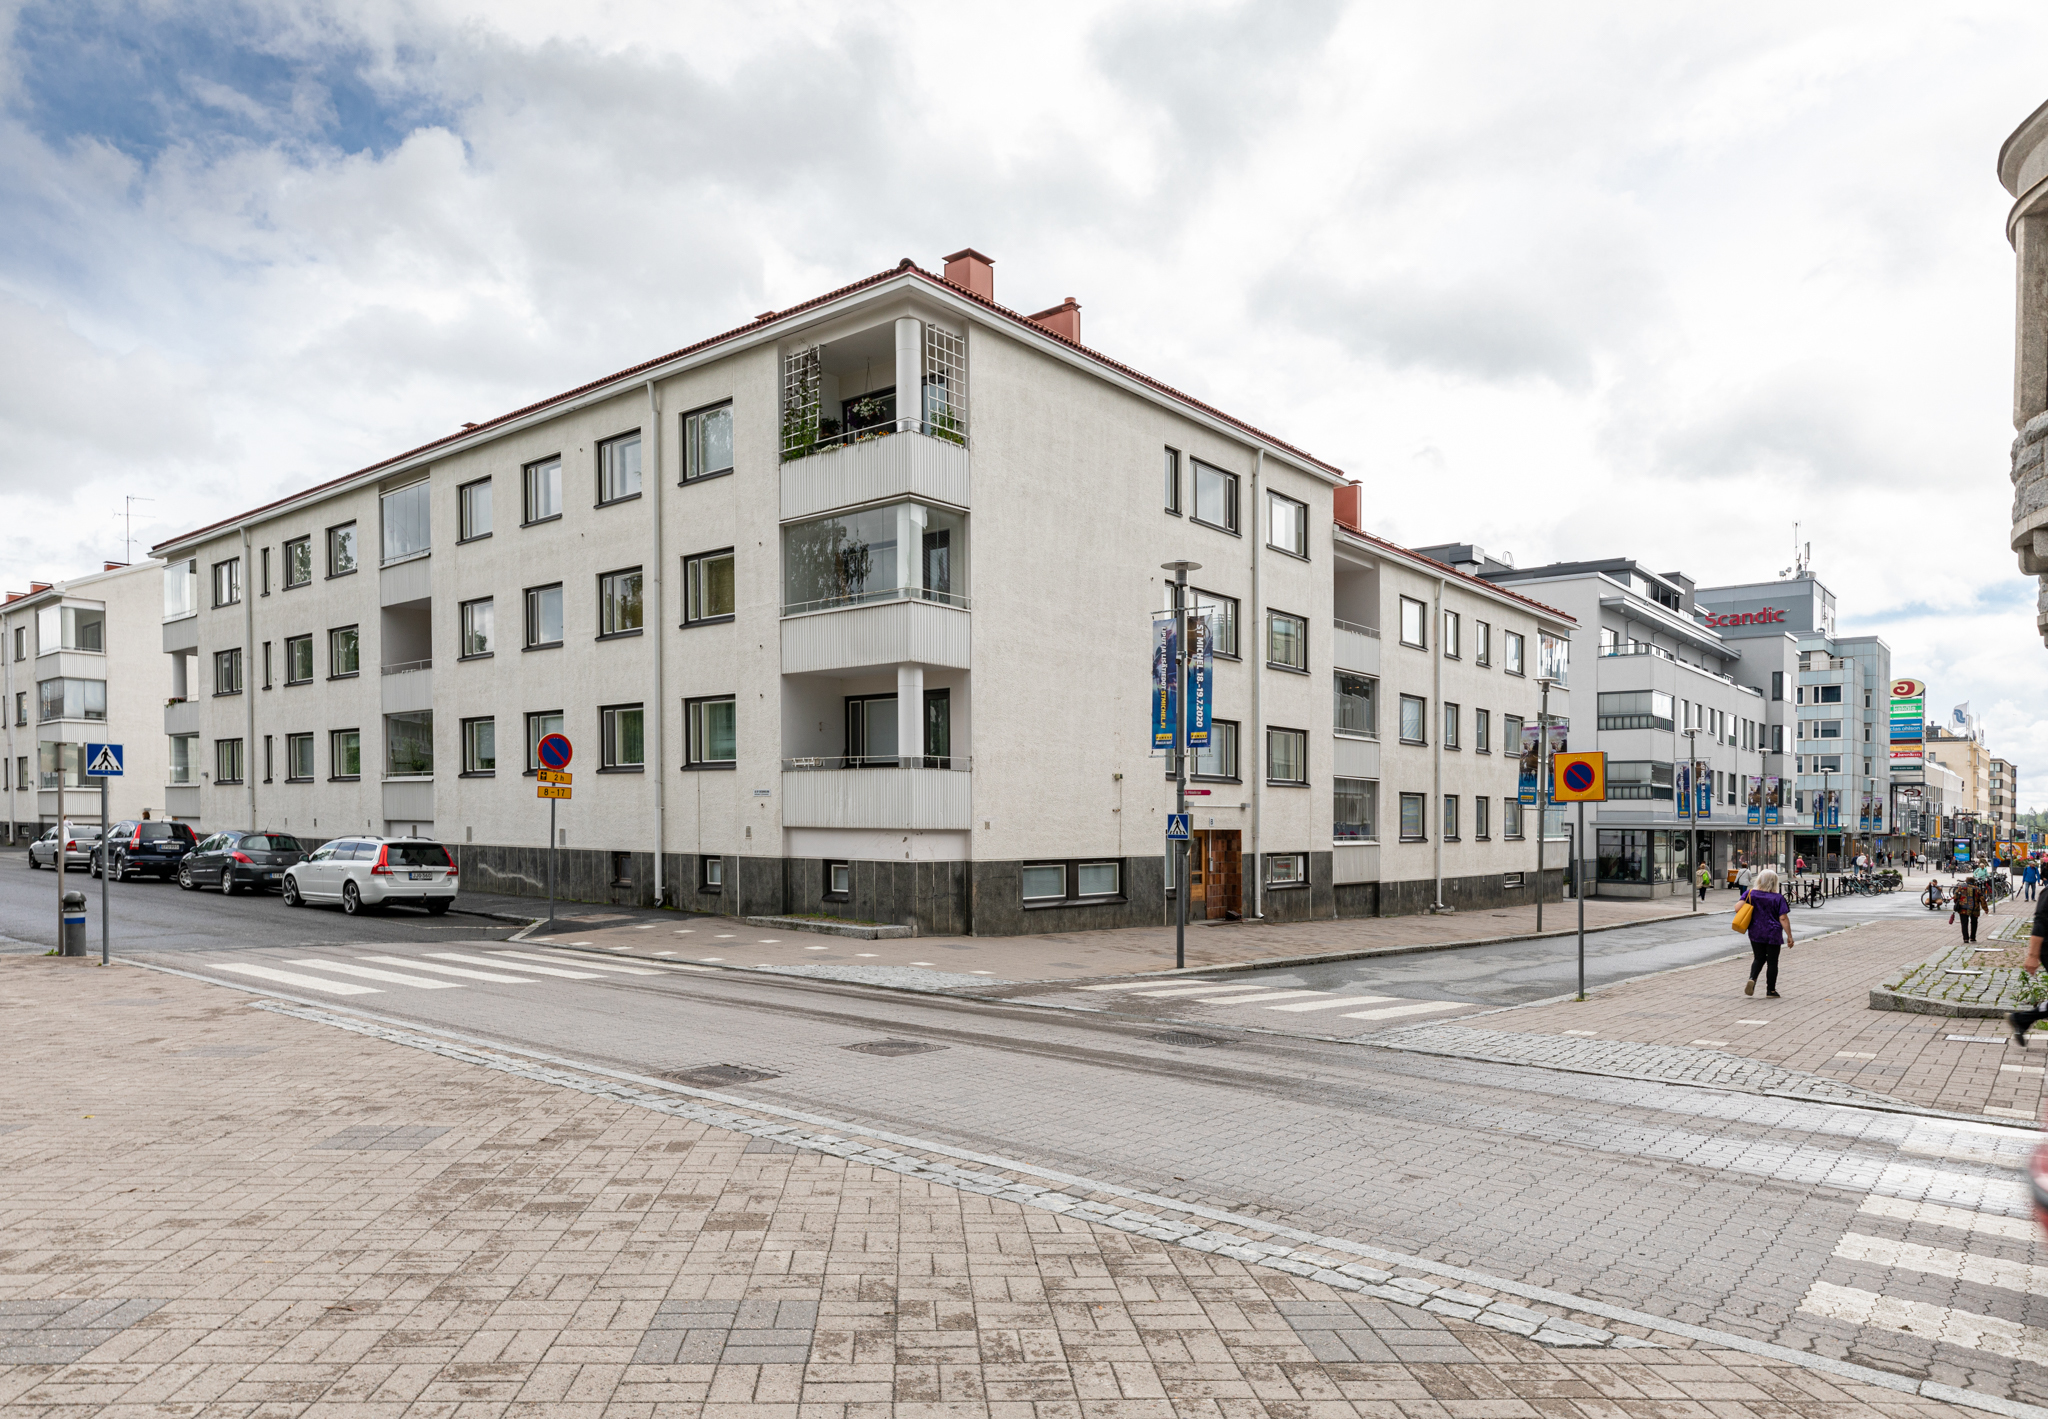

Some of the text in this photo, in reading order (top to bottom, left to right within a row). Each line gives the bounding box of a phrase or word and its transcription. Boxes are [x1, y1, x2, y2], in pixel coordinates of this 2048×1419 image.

[1196, 624, 1204, 636] ST
[1704, 606, 1785, 628] Scandic
[1196, 637, 1204, 670] MICHEL
[1196, 672, 1204, 728] 18.-19.7.2020
